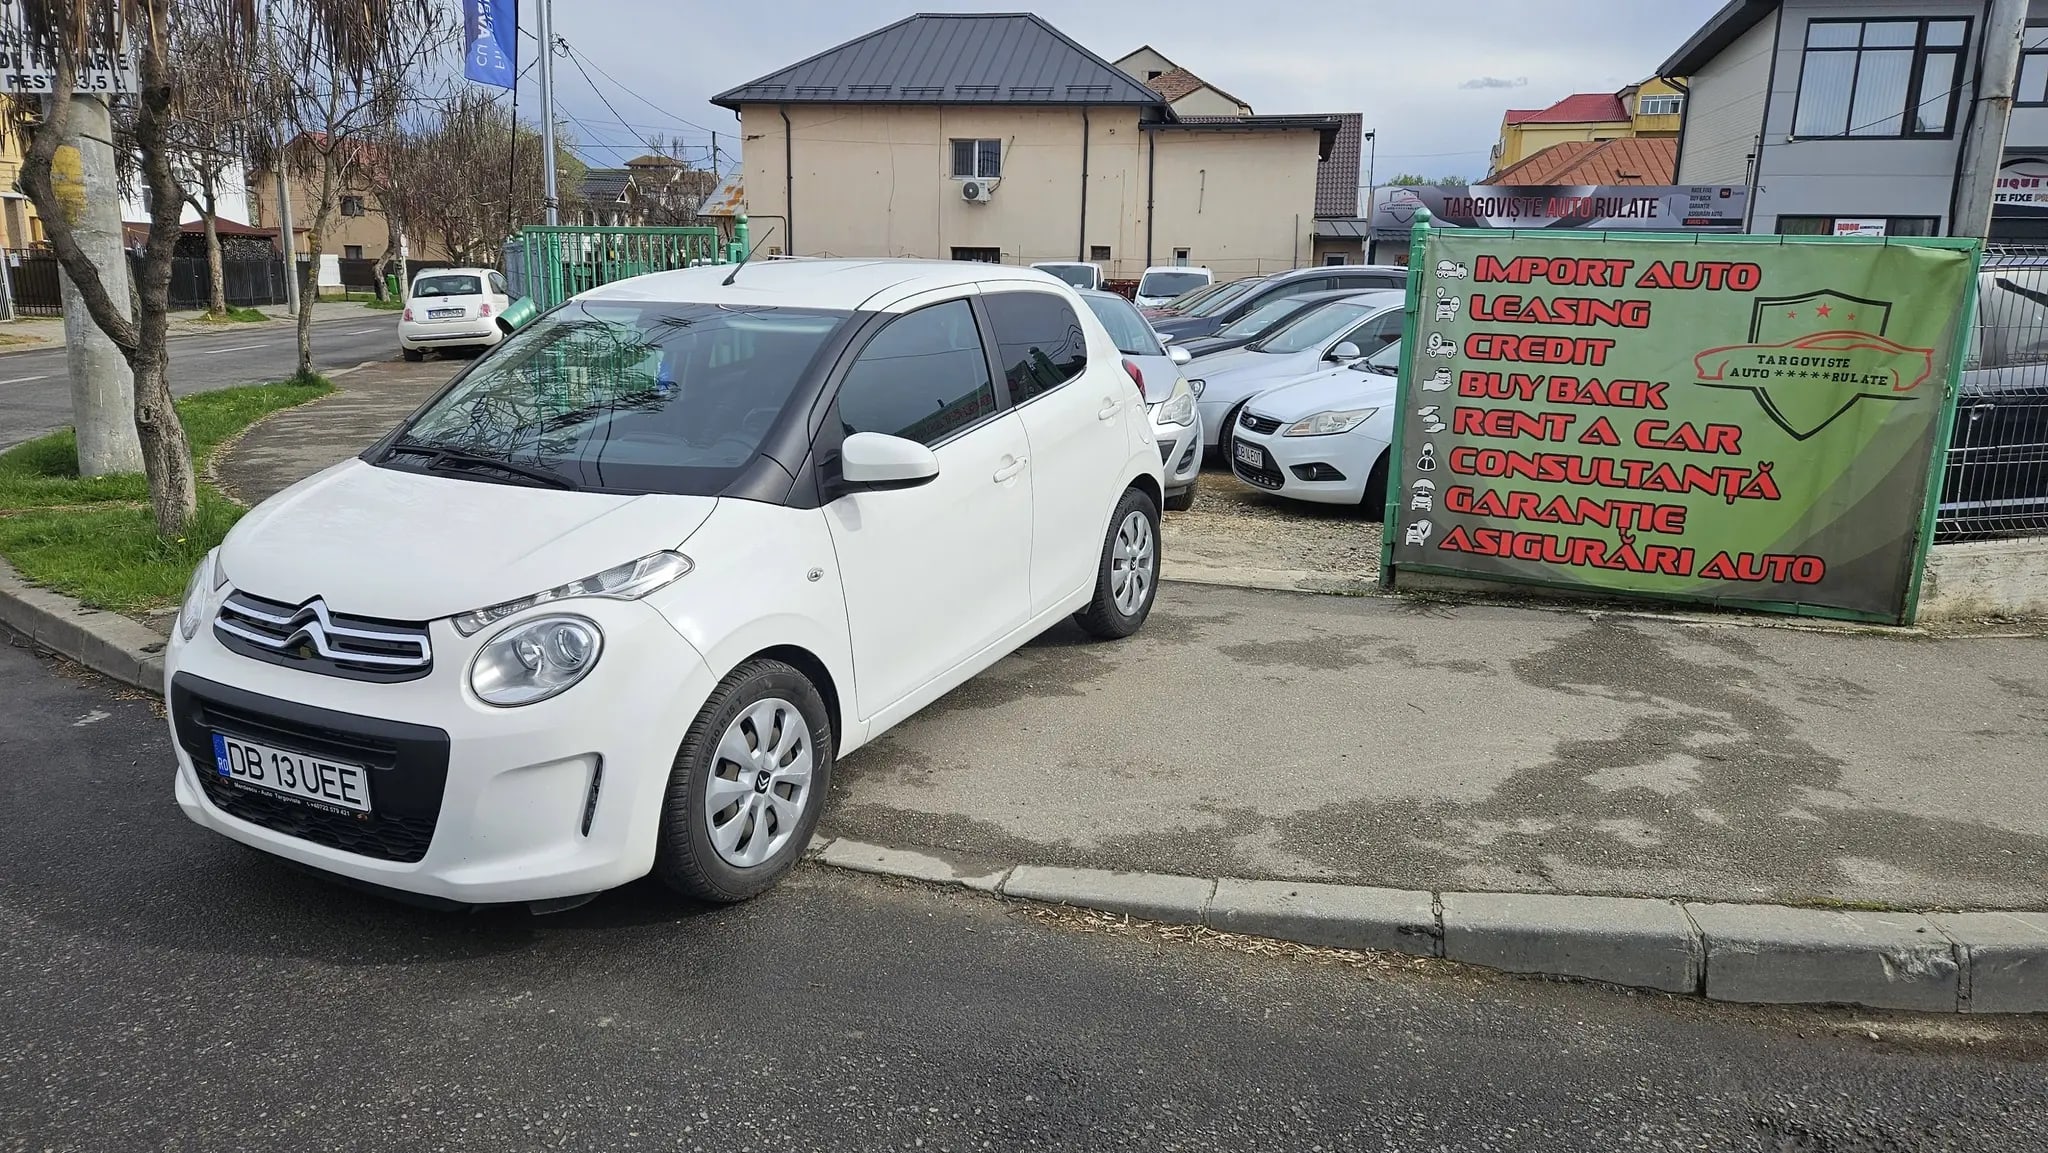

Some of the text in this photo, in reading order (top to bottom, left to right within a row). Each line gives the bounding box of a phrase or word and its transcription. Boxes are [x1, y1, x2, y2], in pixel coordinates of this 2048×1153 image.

[6, 75, 58, 89] PEST
[1545, 196, 1593, 218] AUTO
[1595, 197, 1659, 218] RULATE
[2009, 193, 2033, 202] FIXE
[1474, 255, 1762, 292] IMPORT AUTO
[1470, 294, 1651, 328] LEASING
[1464, 333, 1615, 366] CREDIT
[1757, 355, 1850, 369] TARGOVISTE
[1458, 371, 1669, 410] BUY BACK
[1730, 368, 1888, 386] AUTO RULATE
[1453, 407, 1742, 455] RENT A CAR
[1449, 446, 1781, 504] CONSULTANȚĂ
[1444, 486, 1687, 537] GARANȚIE
[1438, 525, 1826, 585] ASIGURĂRI AUTO
[217, 757, 229, 771] RO
[227, 742, 362, 805] DB 13 UEE
